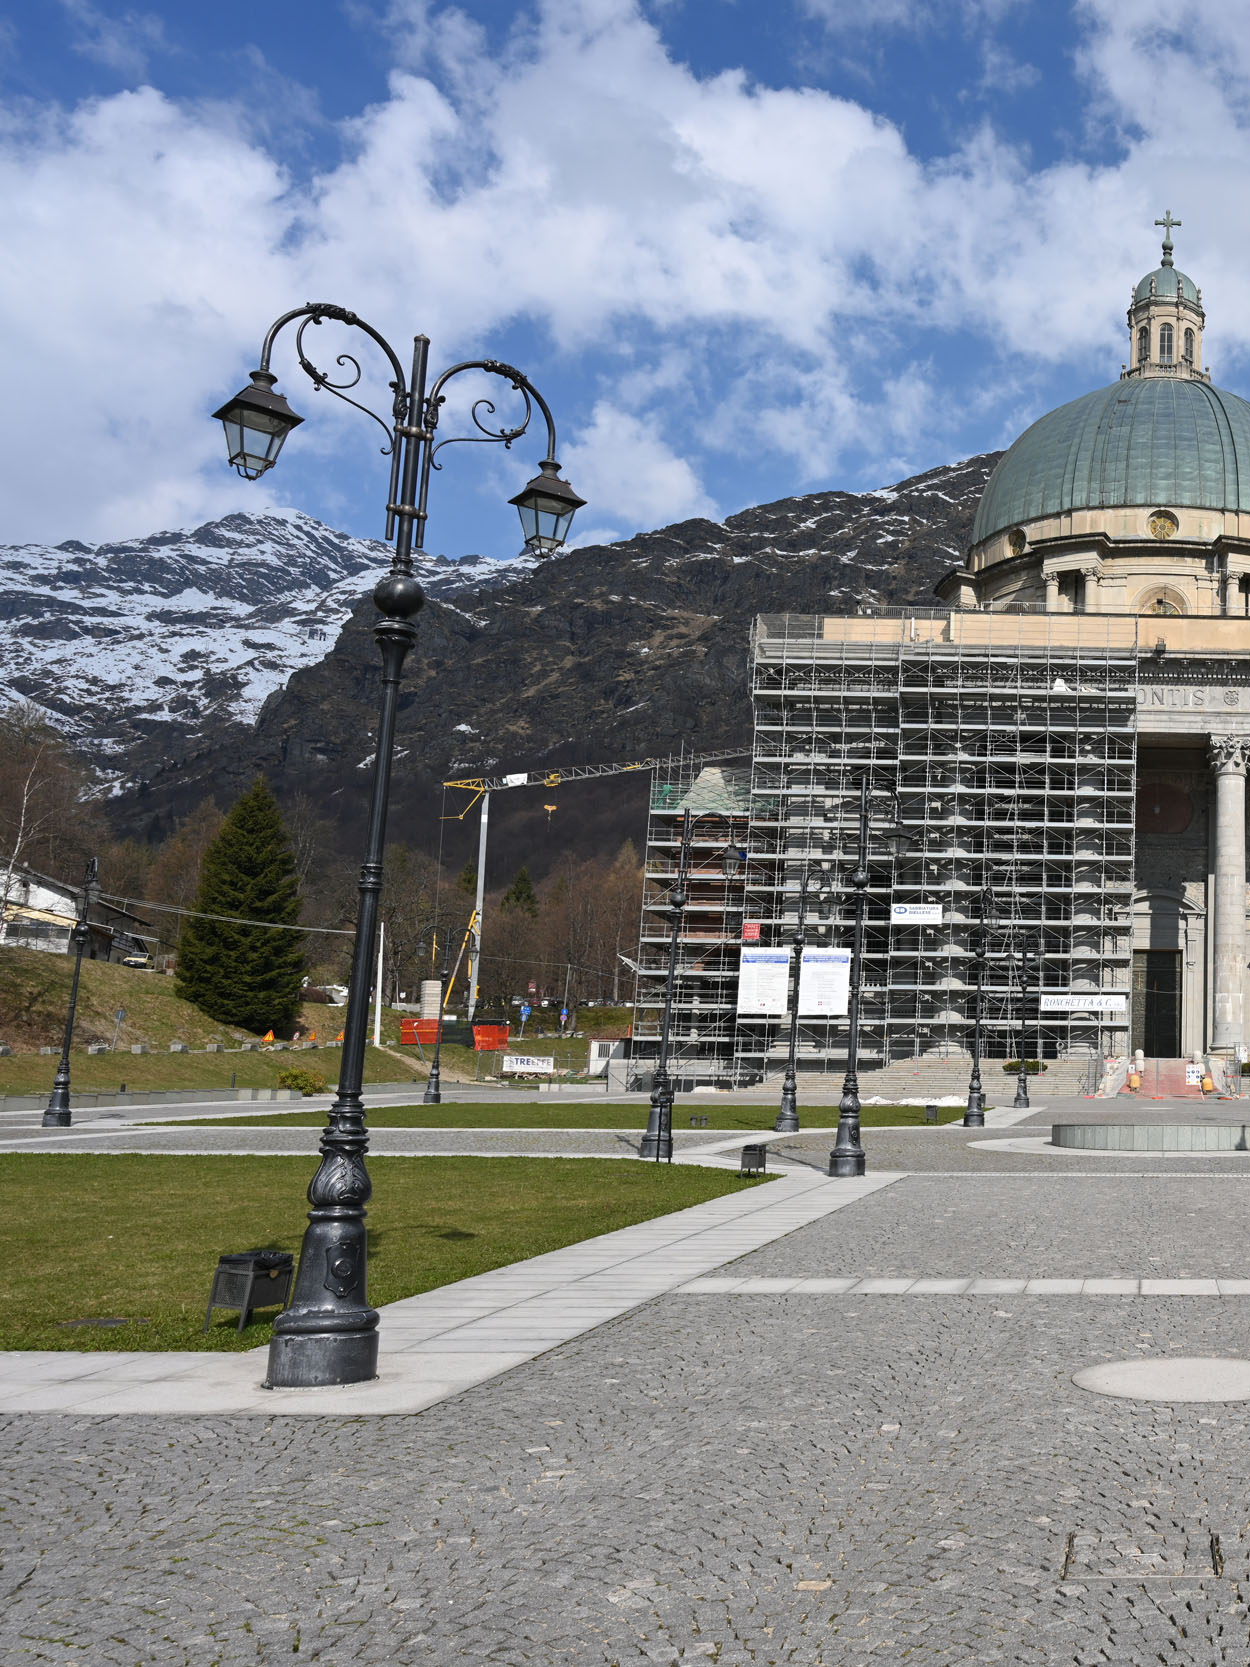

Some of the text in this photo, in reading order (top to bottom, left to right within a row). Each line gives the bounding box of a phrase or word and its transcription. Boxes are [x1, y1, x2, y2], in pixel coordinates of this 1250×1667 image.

[1137, 688, 1205, 706] ONTIS
[1043, 998, 1094, 1007] RONCHETTA
[1096, 998, 1103, 1007] &
